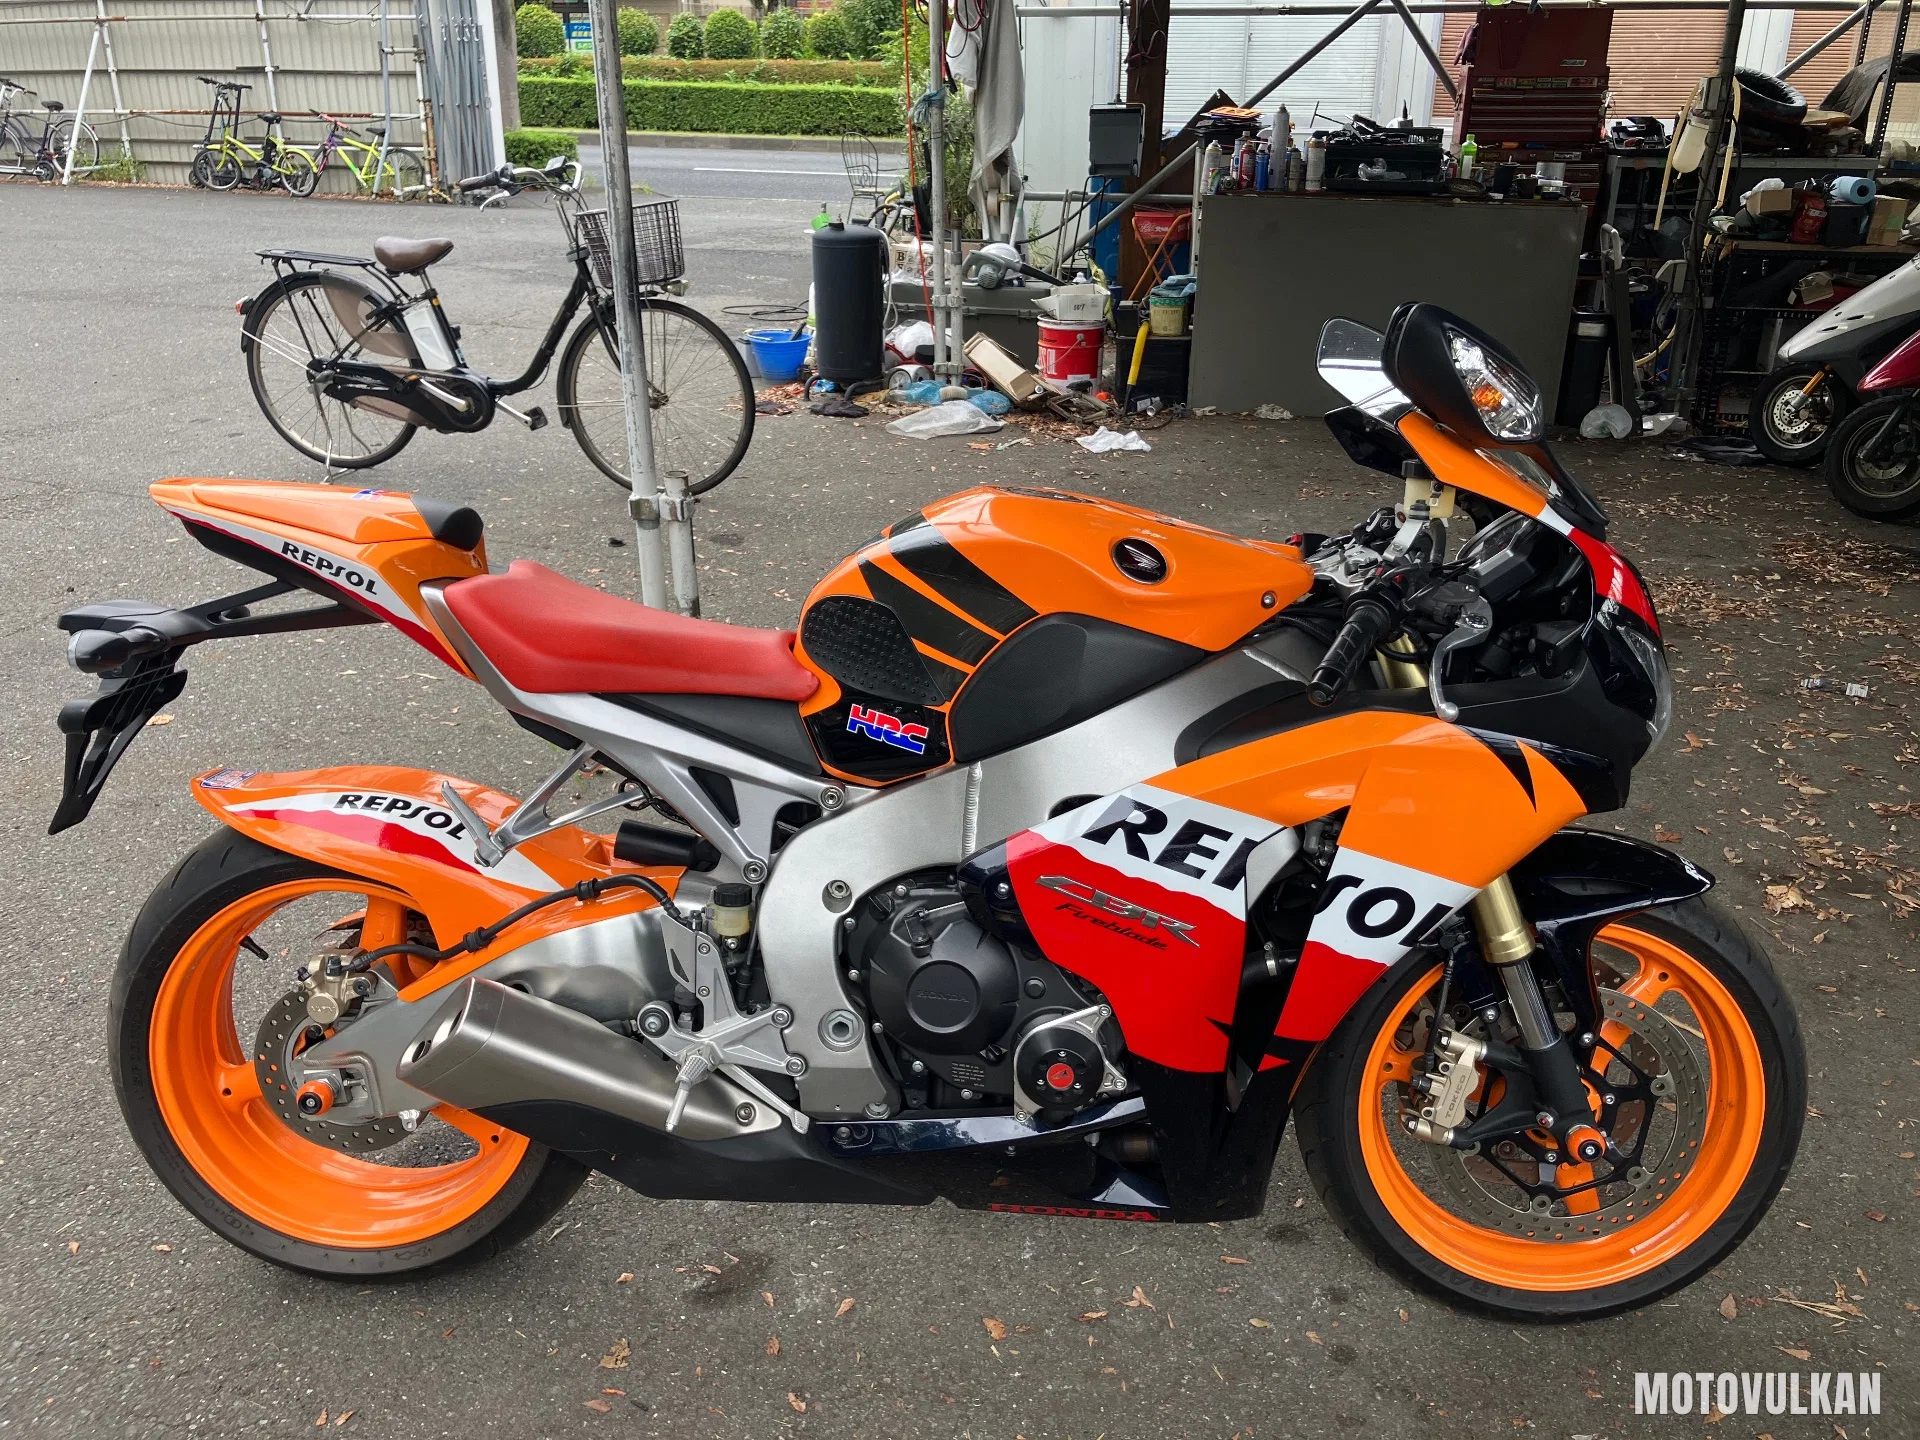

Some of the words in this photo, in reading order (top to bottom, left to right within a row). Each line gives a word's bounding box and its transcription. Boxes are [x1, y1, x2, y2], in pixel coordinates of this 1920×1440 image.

[281, 540, 378, 596] REPSOL
[846, 703, 930, 755] HRC
[333, 794, 466, 841] REPSOL
[1034, 875, 1200, 947] CBR
[1054, 902, 1168, 951] Fireblade
[1444, 1074, 1467, 1118] TOKICO
[987, 1203, 1161, 1222] HONDA
